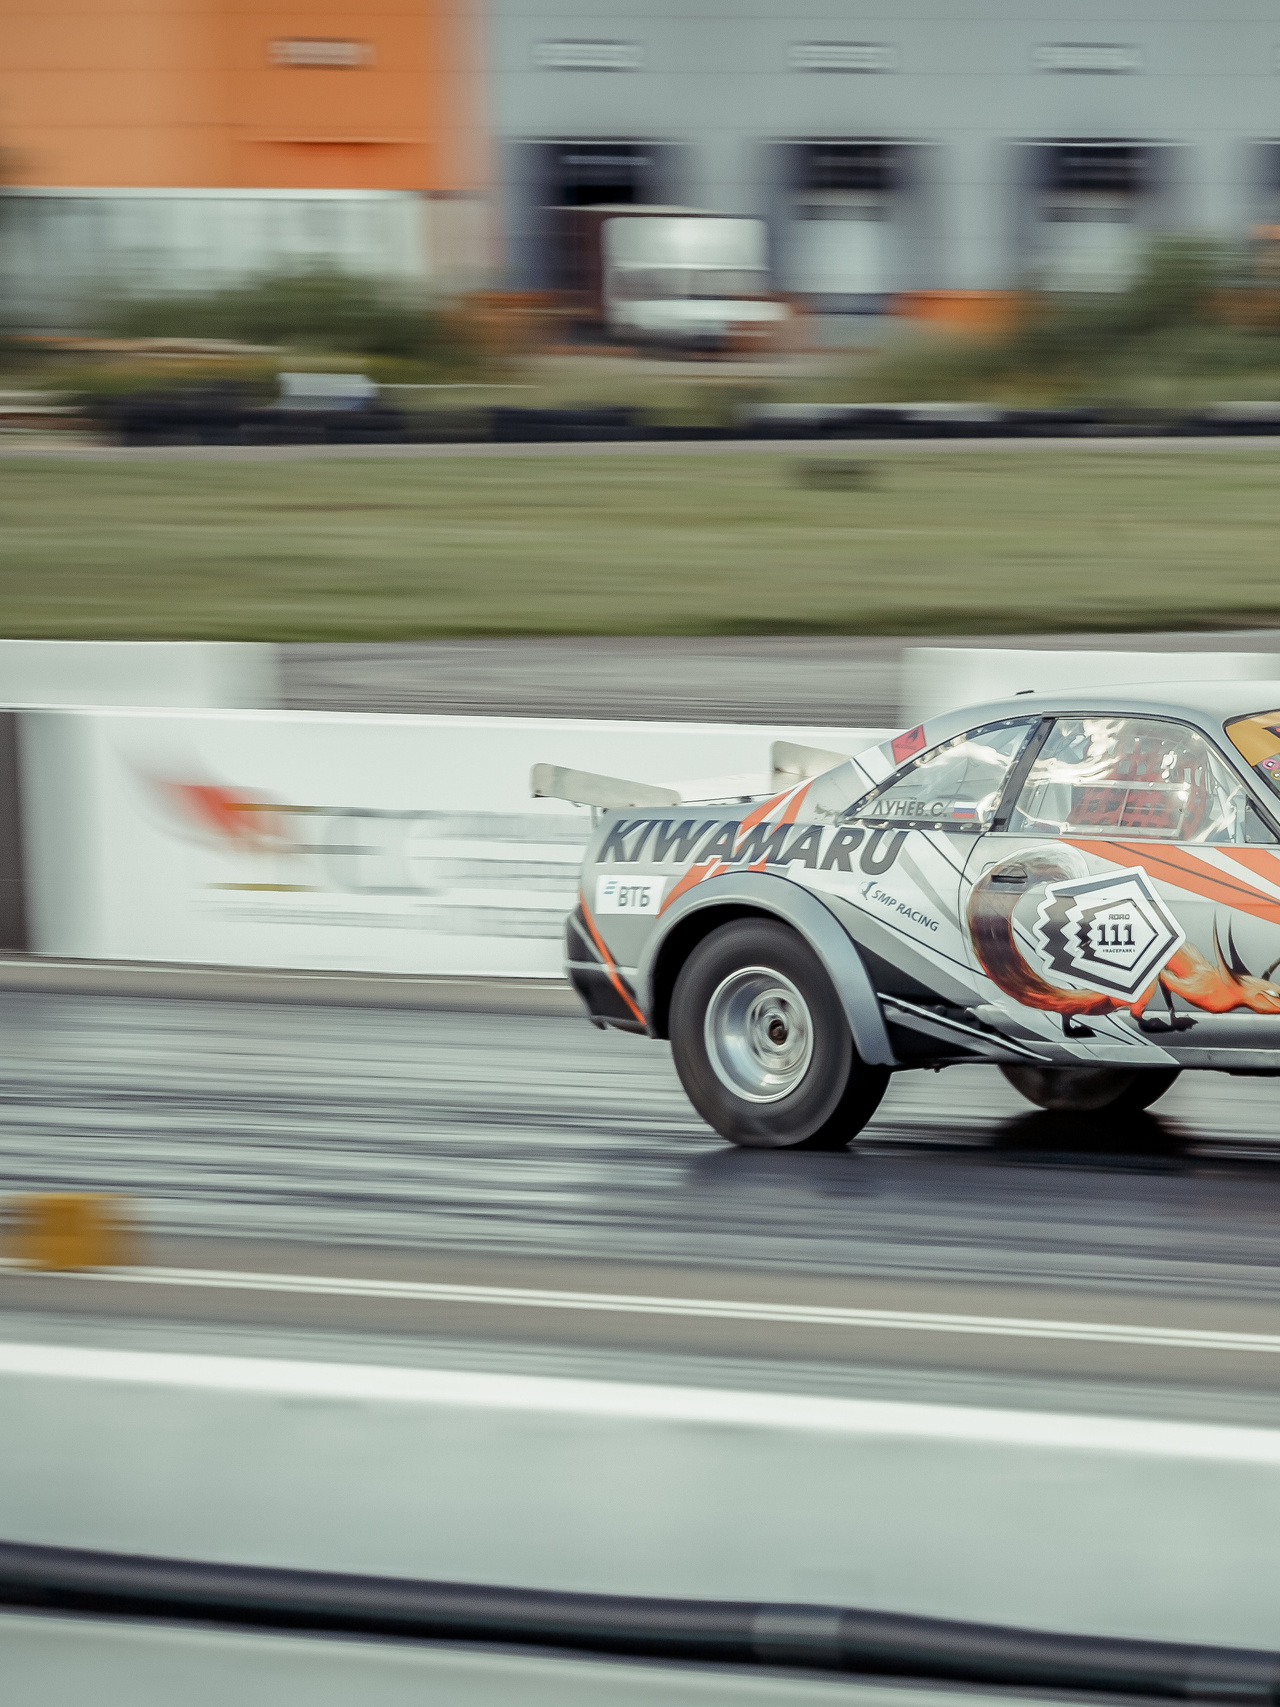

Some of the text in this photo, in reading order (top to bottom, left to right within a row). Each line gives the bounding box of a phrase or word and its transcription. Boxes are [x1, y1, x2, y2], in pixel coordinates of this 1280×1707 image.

[596, 820, 910, 875] KIWAMARU
[618, 886, 651, 907] ВТБ
[871, 889, 940, 932] SMP RACING
[1097, 924, 1136, 946] 111
